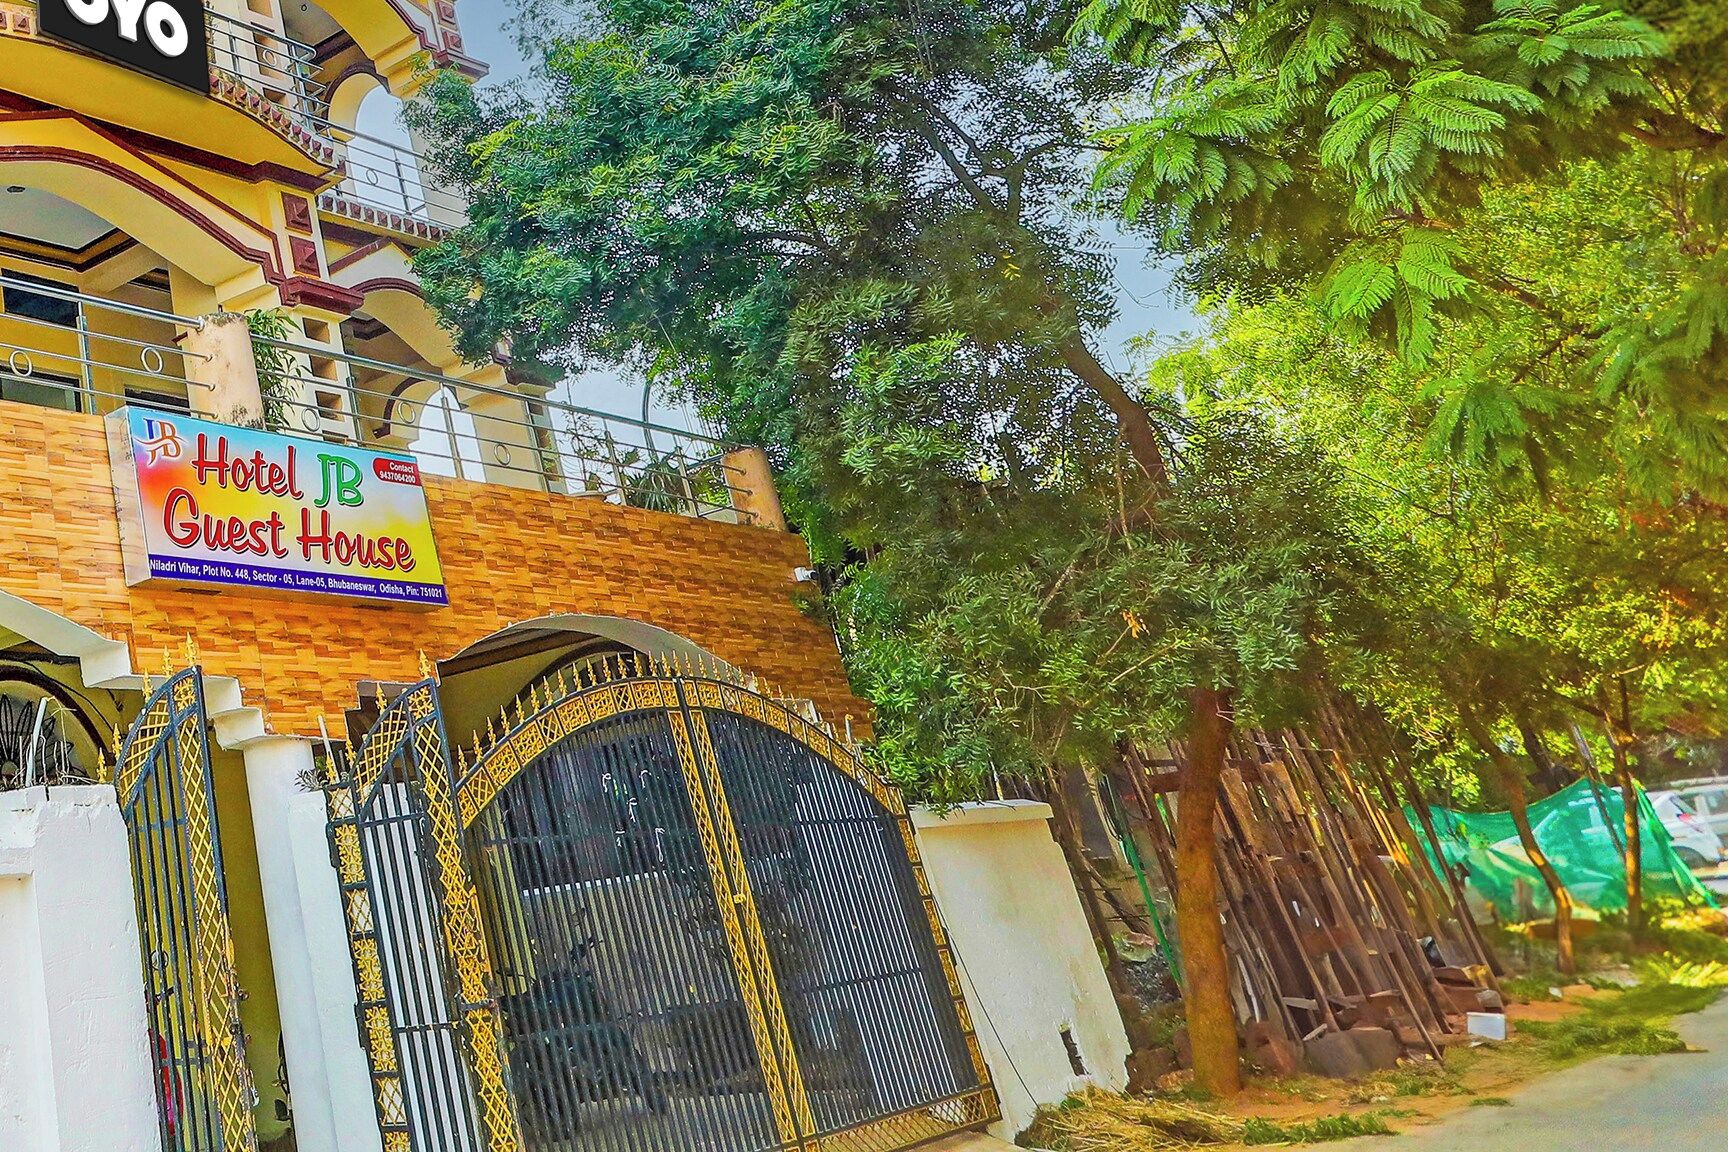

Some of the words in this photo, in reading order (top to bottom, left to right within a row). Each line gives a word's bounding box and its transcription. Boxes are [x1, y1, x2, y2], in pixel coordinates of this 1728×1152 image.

[191, 432, 303, 499] Hotel
[314, 453, 364, 507] JB
[389, 461, 414, 474] Contact
[163, 487, 287, 556] Guest
[296, 507, 416, 572] House
[150, 559, 177, 572] Niladri
[178, 561, 201, 576] Vihar,
[203, 564, 218, 577] Plot
[220, 568, 233, 578] No.
[235, 568, 251, 581] 448,
[252, 571, 278, 583] Sector
[283, 574, 295, 586] 05,
[296, 575, 327, 589] Lane-05,
[328, 579, 377, 594] Bhubaneswar,
[379, 583, 405, 597] Odisha,
[406, 585, 419, 597] Pin:
[420, 587, 442, 598] 751021
